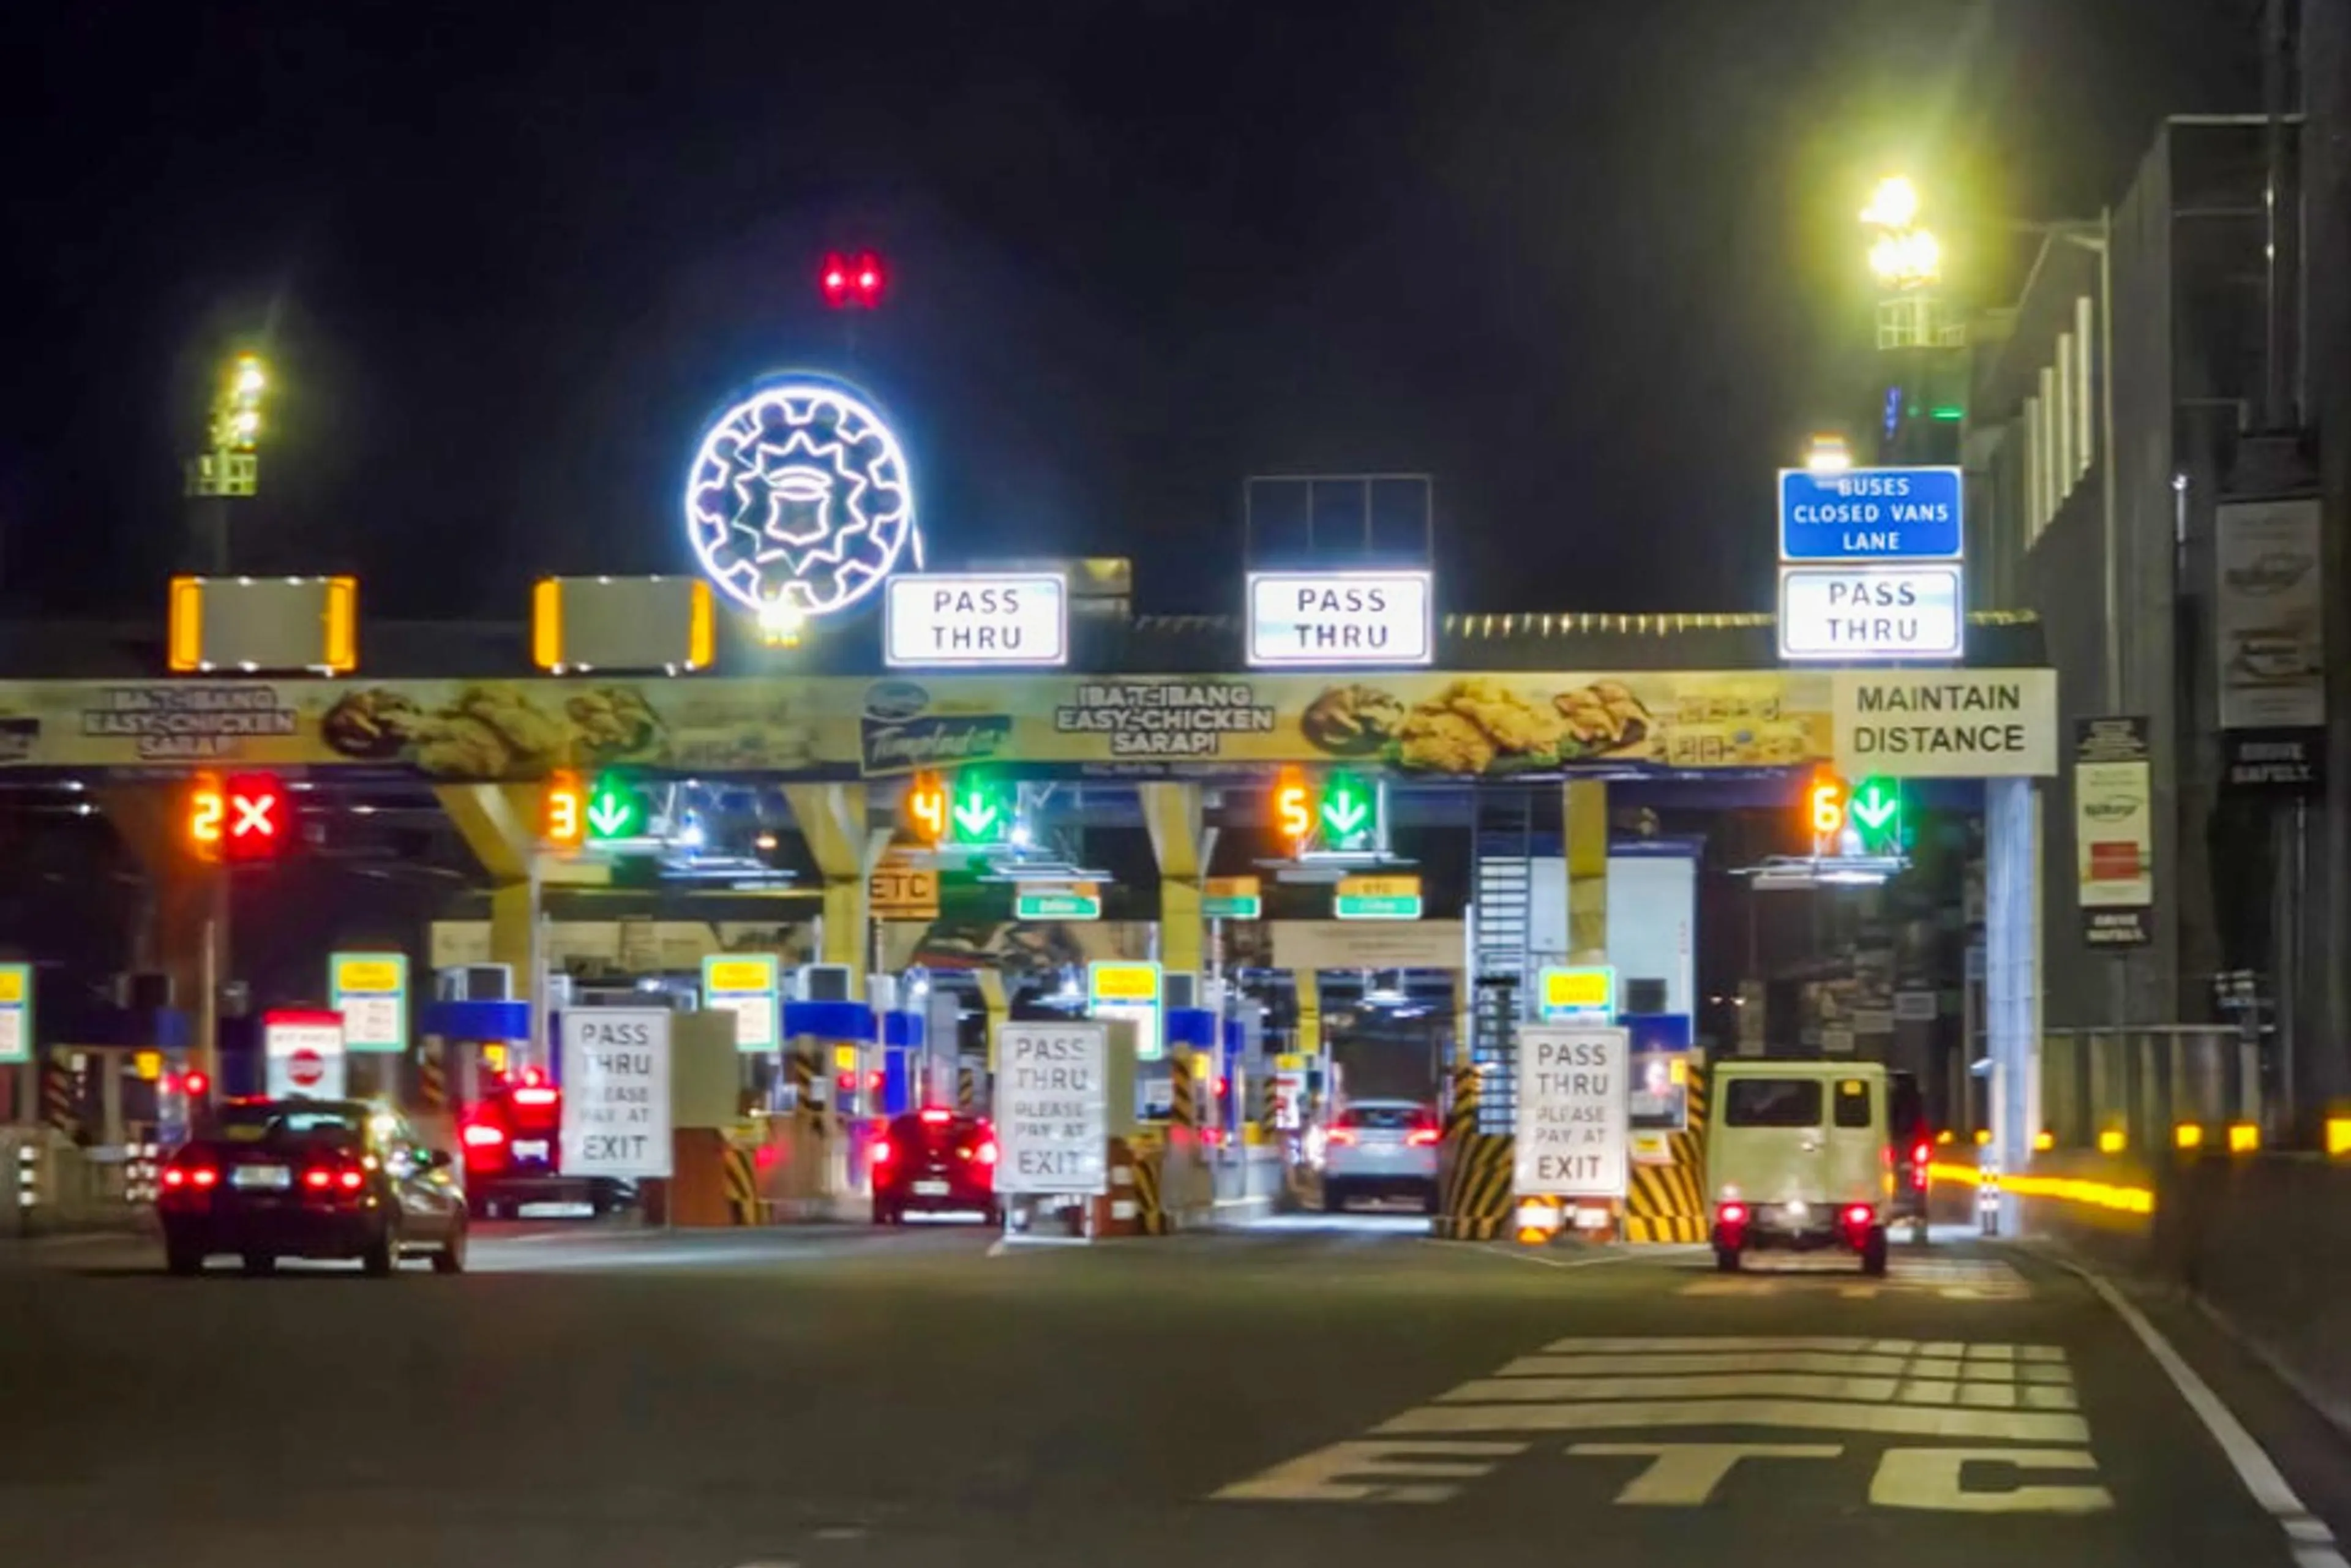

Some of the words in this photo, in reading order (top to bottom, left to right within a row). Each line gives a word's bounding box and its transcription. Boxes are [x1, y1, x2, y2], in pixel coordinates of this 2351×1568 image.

[1838, 478, 1910, 497] BUSES
[1793, 504, 1879, 523] CLOSED
[1890, 503, 1948, 522] VANS
[1843, 532, 1901, 550] LANE
[934, 590, 1019, 613] PASS
[1298, 588, 1385, 612] PASS
[1829, 582, 1916, 606] PASS
[932, 626, 1022, 649] THRU
[1294, 625, 1387, 648] THRU
[1826, 618, 1917, 642] THRU
[1858, 685, 2020, 712] MAINTAIN
[1854, 725, 2025, 753] DISTANCE
[192, 794, 222, 840] 2
[551, 793, 576, 838] 3
[913, 792, 942, 833] 4
[1280, 790, 1308, 835] 5
[1812, 787, 1841, 831] 6
[870, 874, 928, 898] ETC
[581, 1023, 648, 1045] PASS
[1016, 1038, 1086, 1060] PASS
[1538, 1043, 1607, 1066] PASS
[1016, 1067, 1089, 1090] THRU
[1536, 1073, 1609, 1095] THRU
[627, 1108, 650, 1122] AT
[1015, 1101, 1084, 1117] PLEASE
[1536, 1106, 1605, 1123] PLEASE
[1063, 1122, 1087, 1138] AT
[1536, 1129, 1571, 1144] PAY
[1583, 1128, 1605, 1144] AT
[583, 1136, 648, 1160] EXIT
[1019, 1150, 1080, 1174] EXIT
[1539, 1157, 1602, 1179] EXIT
[1205, 1440, 2116, 1512] ETC
